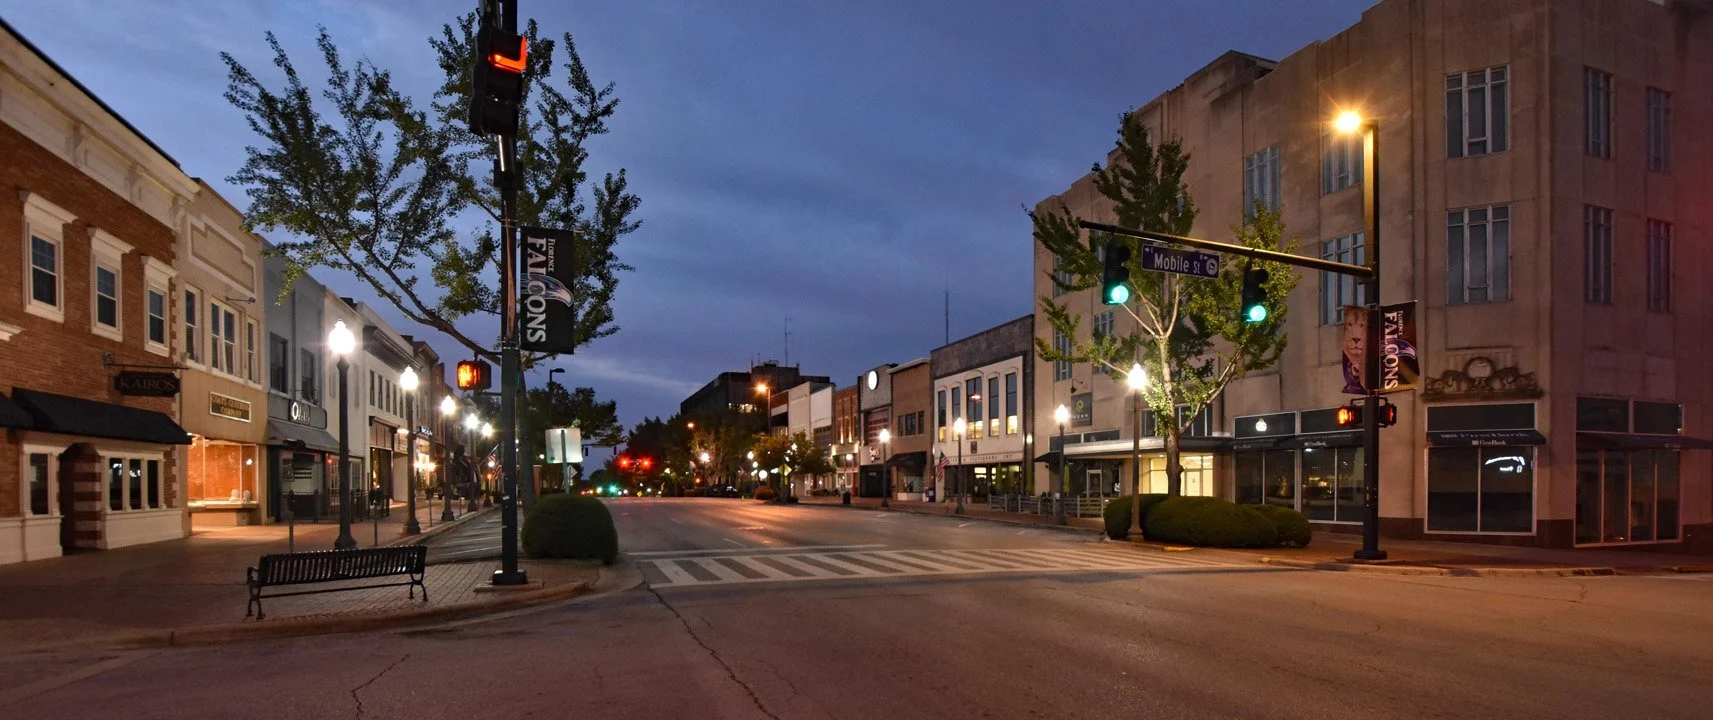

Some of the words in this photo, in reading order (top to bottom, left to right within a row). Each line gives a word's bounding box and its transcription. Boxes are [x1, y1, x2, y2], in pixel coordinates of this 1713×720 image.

[548, 238, 556, 273] FLORENCE
[1154, 253, 1190, 272] Mobile
[1193, 260, 1201, 274] St
[526, 236, 547, 343] FALCONS
[1384, 311, 1399, 390] FALCONS
[120, 377, 176, 390] KAIROS
